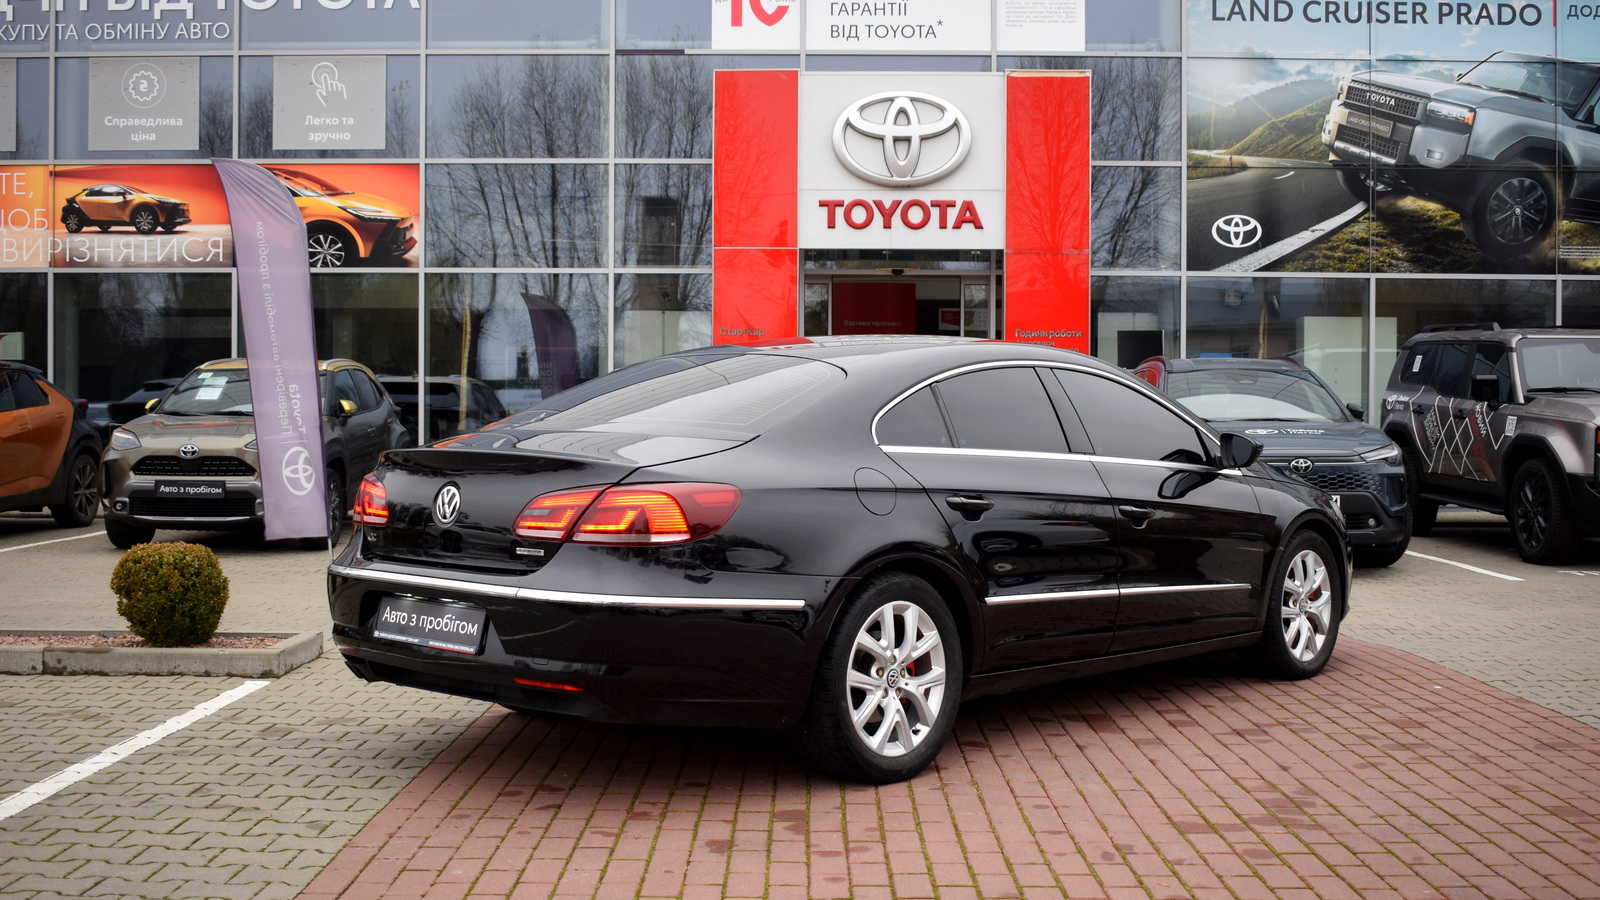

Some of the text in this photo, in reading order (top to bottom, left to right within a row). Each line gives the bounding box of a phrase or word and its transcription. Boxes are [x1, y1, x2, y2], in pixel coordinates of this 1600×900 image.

[1212, 0, 1542, 27] LAND CRUISER PRADO
[56, 24, 78, 40] ТА
[85, 23, 169, 40] ОБМІНУ
[175, 22, 230, 39] АВТО
[830, 24, 860, 41] ВІД
[1366, 92, 1395, 106] TOYOTA
[104, 116, 183, 128] Справедлива
[304, 115, 354, 125] Легко та
[131, 131, 156, 142] ціна
[308, 132, 351, 142] зручно
[818, 199, 984, 229] TOYOTA
[0, 208, 48, 236] ОБ
[3, 236, 224, 263] ВИРІЗНЯТИСЯ
[719, 327, 765, 336] Стар-Кар
[1015, 328, 1082, 339] Години роботи
[159, 485, 178, 493] Авто
[185, 485, 222, 494] пробігом
[382, 606, 478, 636] Авто з пробігом
